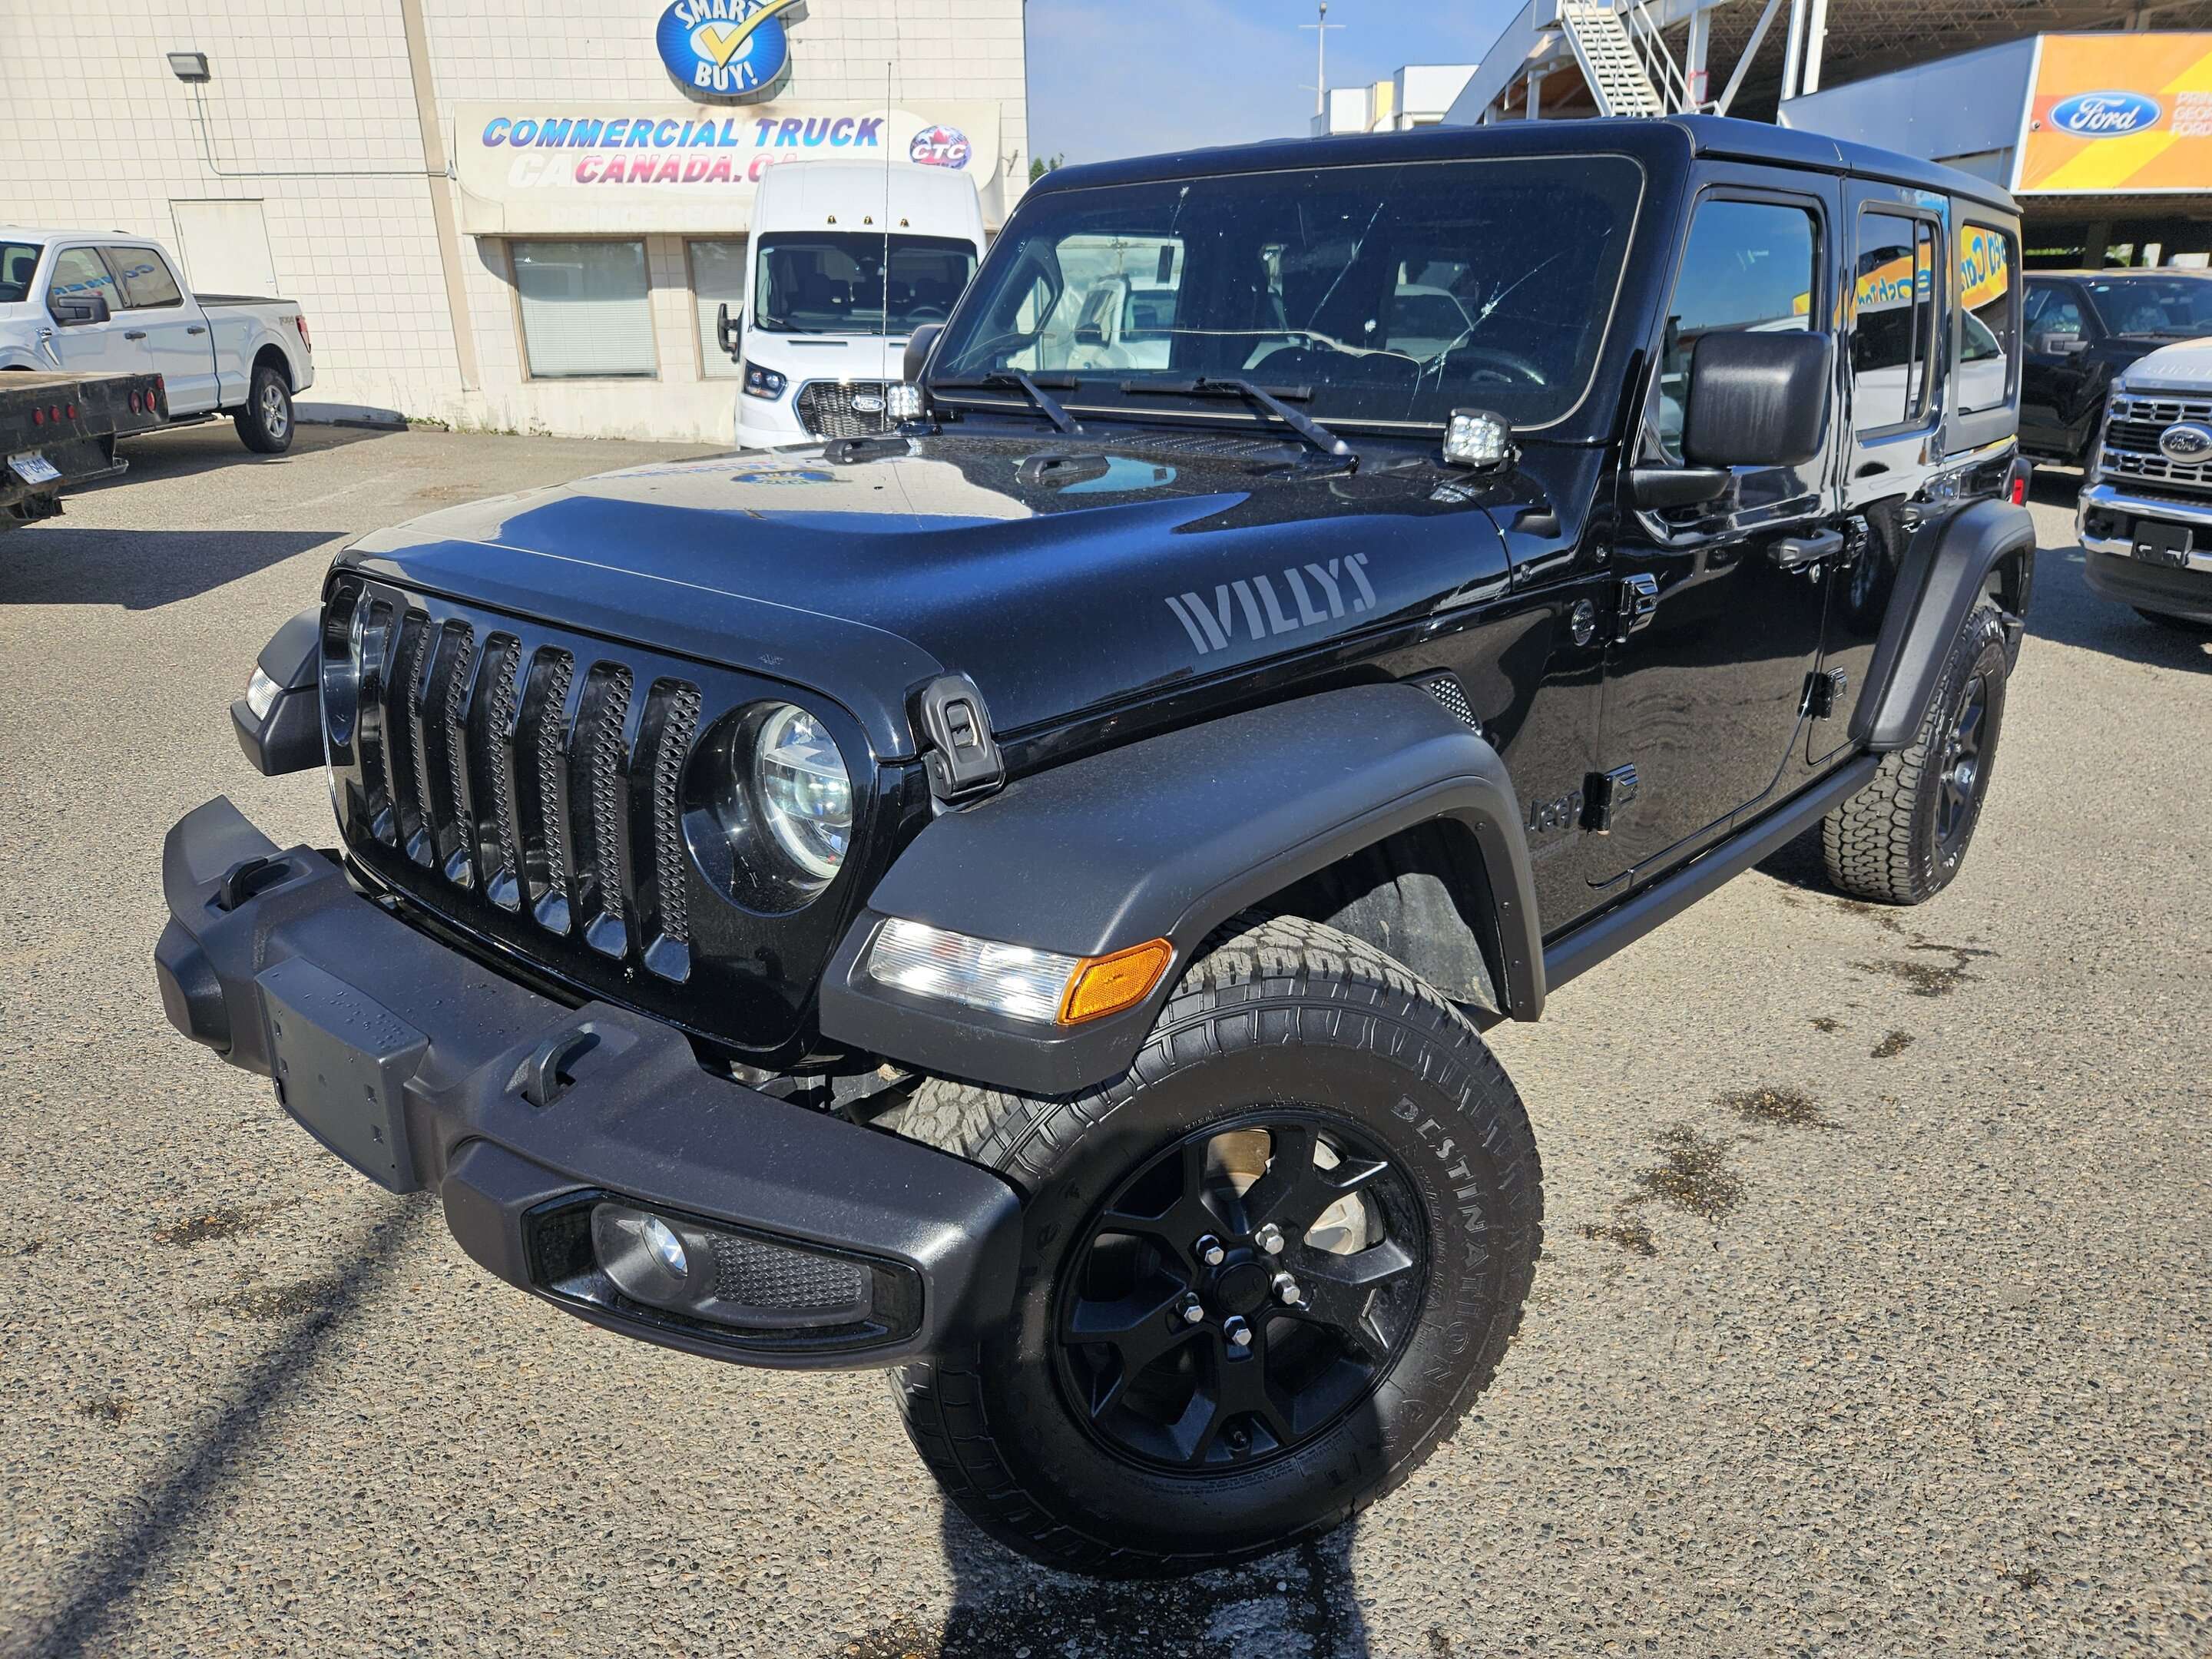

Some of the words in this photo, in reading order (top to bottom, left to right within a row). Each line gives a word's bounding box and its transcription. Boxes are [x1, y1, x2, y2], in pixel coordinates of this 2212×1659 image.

[694, 61, 758, 91] BUY!
[2070, 98, 2142, 131] Ford
[482, 118, 740, 148] COMMERCIAL
[754, 118, 885, 147] TRUCK
[912, 144, 966, 160] CTC
[1164, 552, 1376, 655] WILLYS
